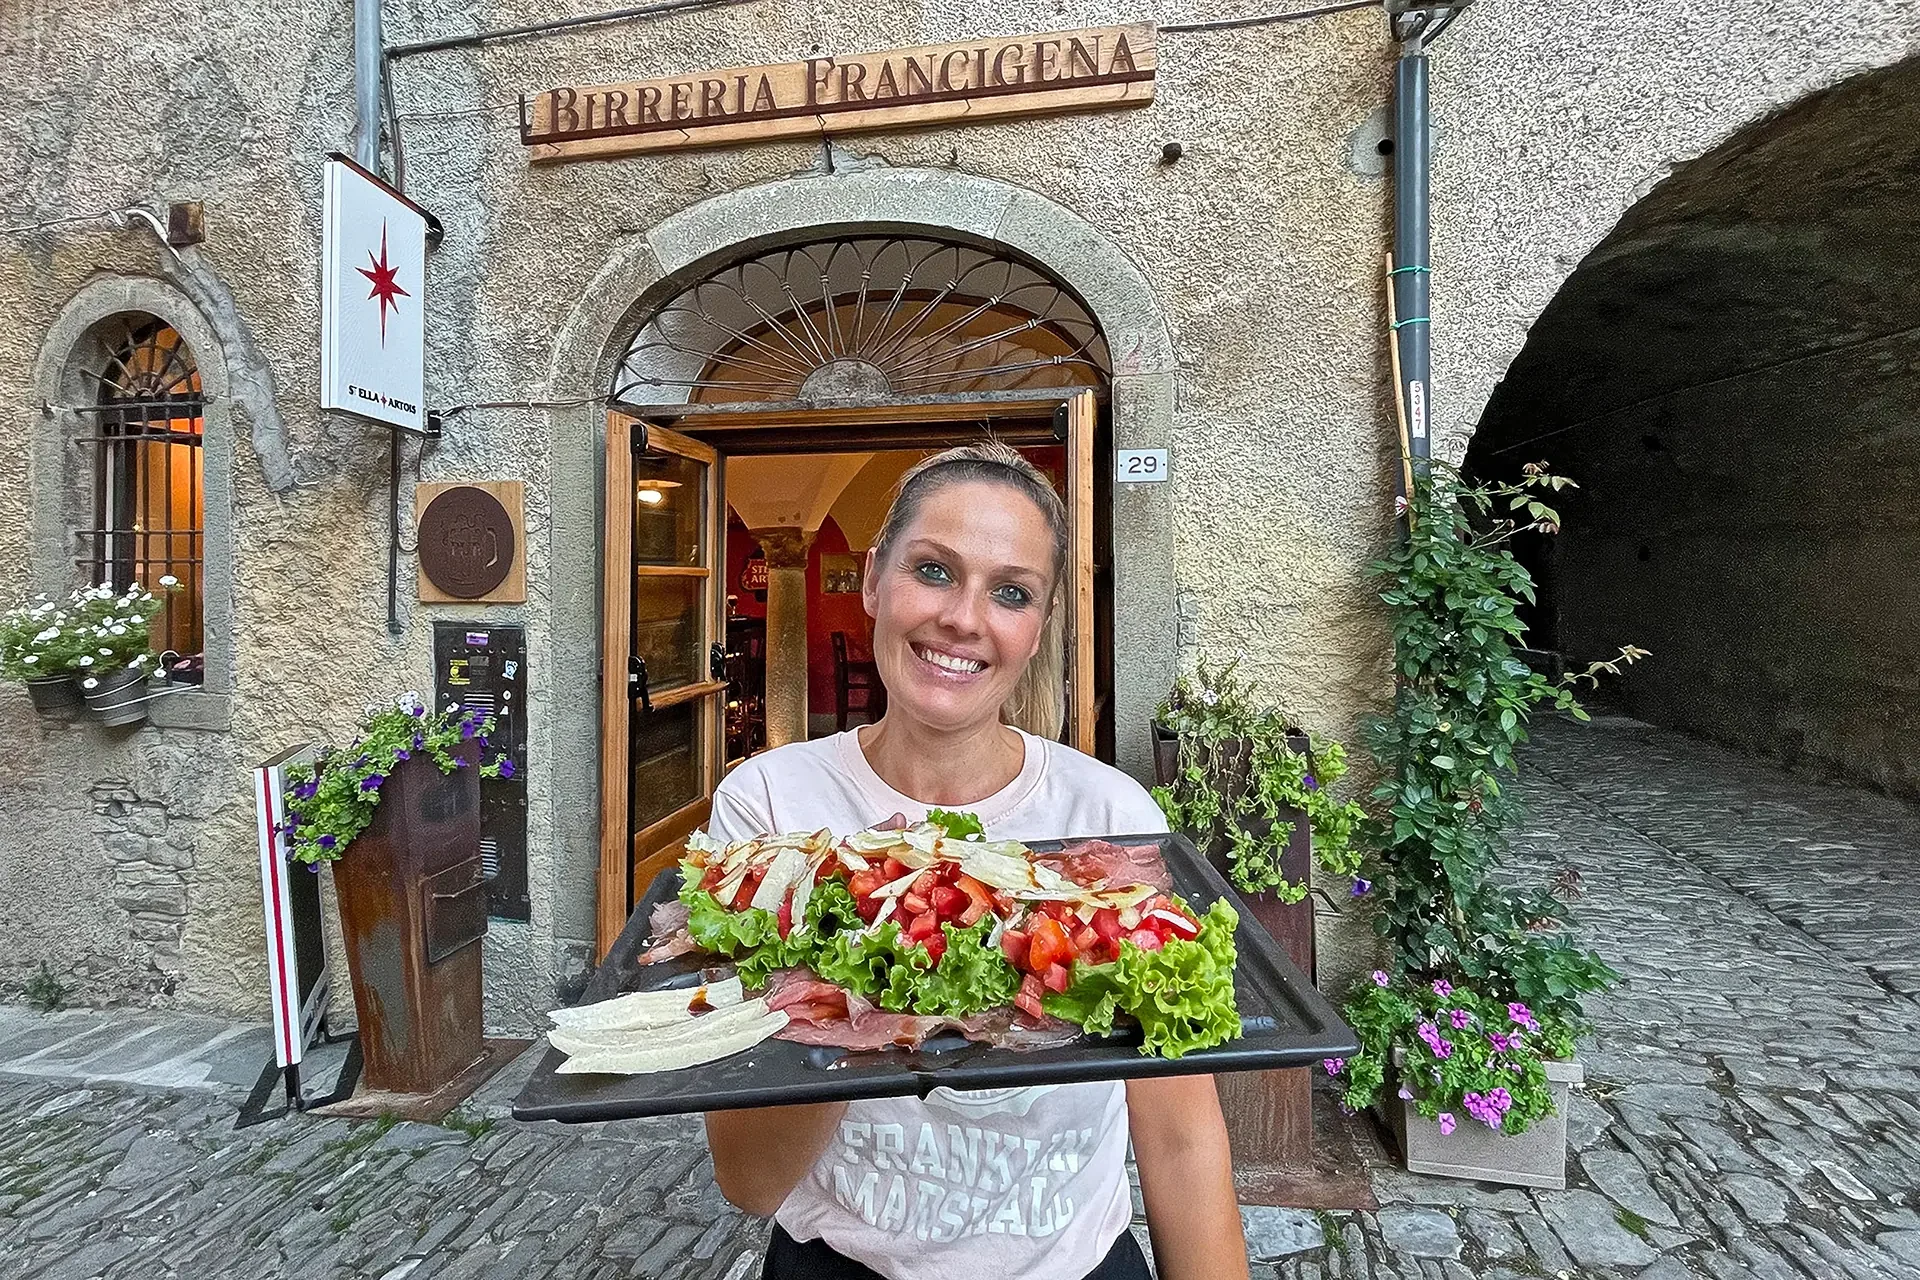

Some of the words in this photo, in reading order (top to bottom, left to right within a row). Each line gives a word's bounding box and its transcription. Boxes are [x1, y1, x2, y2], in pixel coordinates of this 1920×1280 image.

[549, 72, 777, 133] BIRRERIA
[803, 32, 1139, 106] FRANCIGENA
[348, 384, 380, 403] STELLA
[388, 397, 417, 415] ARTOIS
[1128, 456, 1157, 474] 29
[750, 574, 769, 583] AR
